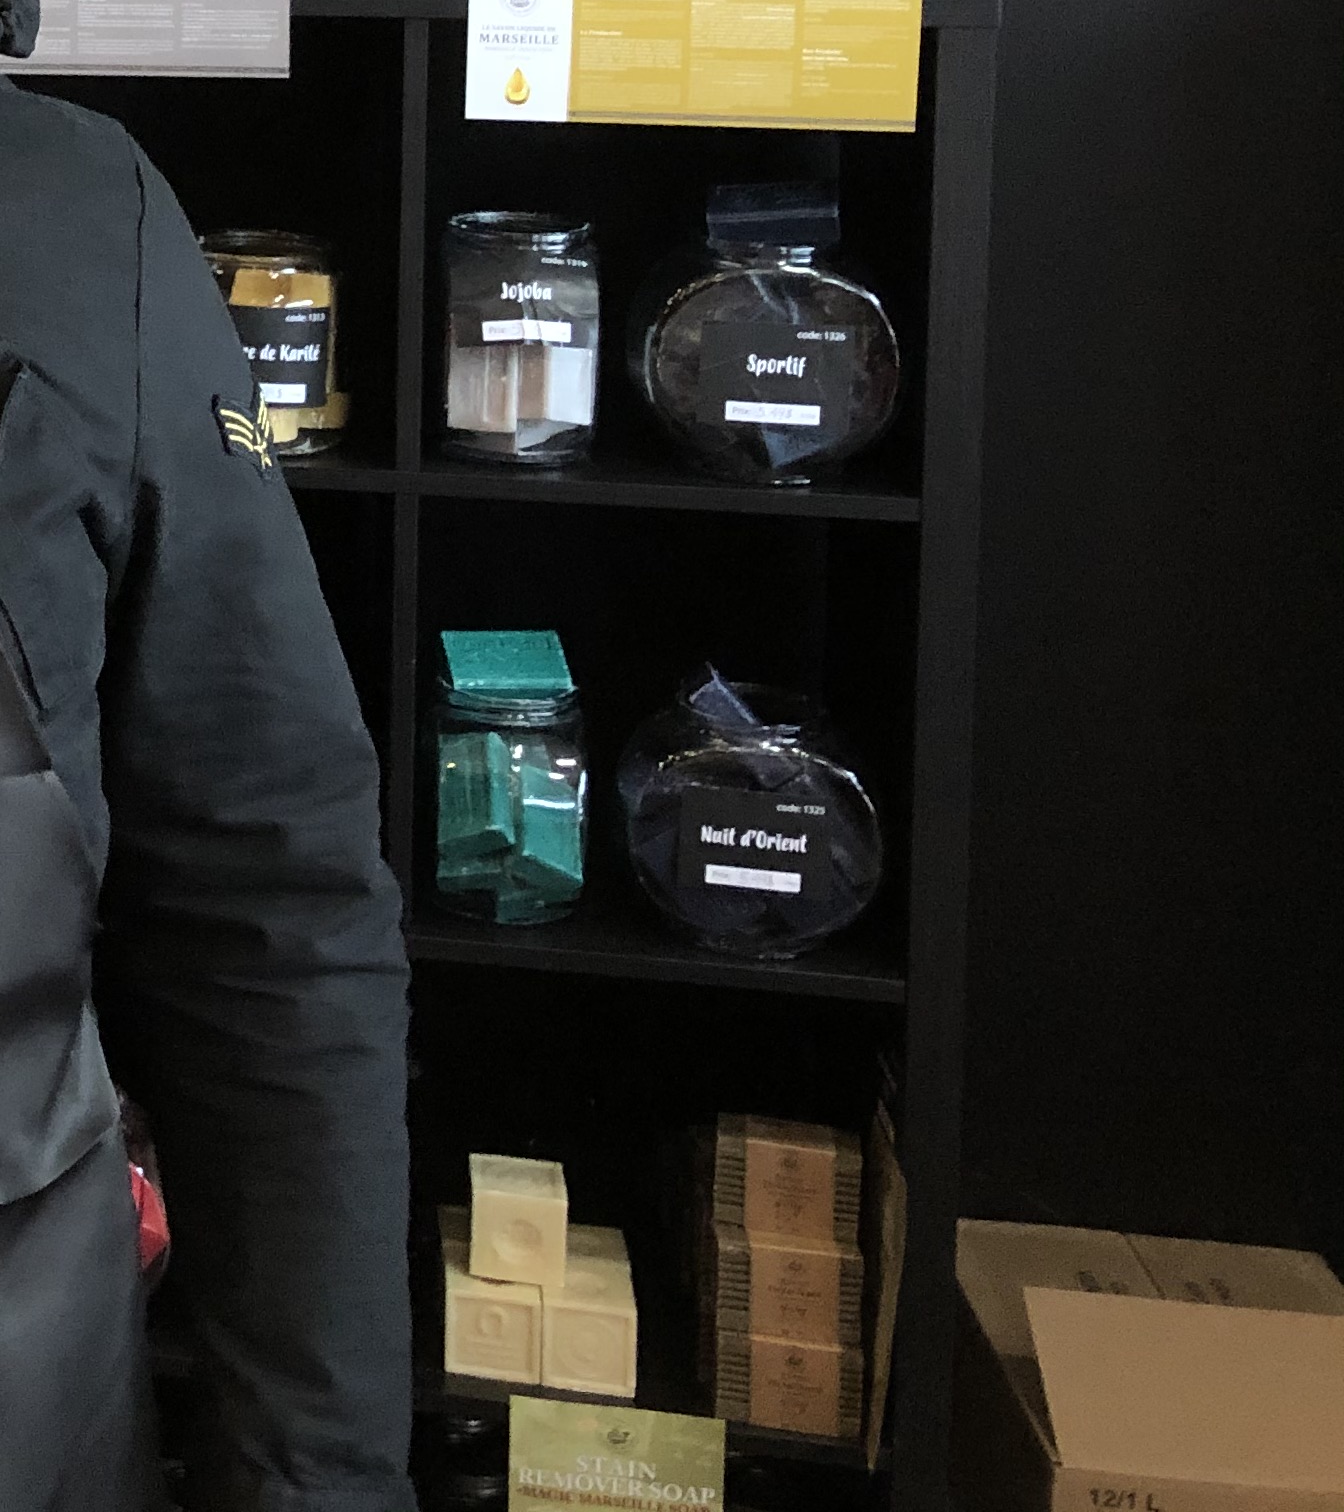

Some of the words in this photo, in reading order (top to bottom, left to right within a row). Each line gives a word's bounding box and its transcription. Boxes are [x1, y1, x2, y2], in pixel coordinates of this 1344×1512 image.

[479, 33, 559, 45] MARSEILLE
[500, 281, 552, 303] Jojoba
[259, 343, 276, 361] de
[279, 343, 321, 362] Karité
[746, 353, 807, 378] Sportif
[700, 824, 736, 847] Nuit
[740, 829, 808, 854] d'Orient
[576, 1454, 657, 1481] STAIN
[518, 1468, 646, 1498] REMOVER
[647, 1481, 716, 1504] SOAP
